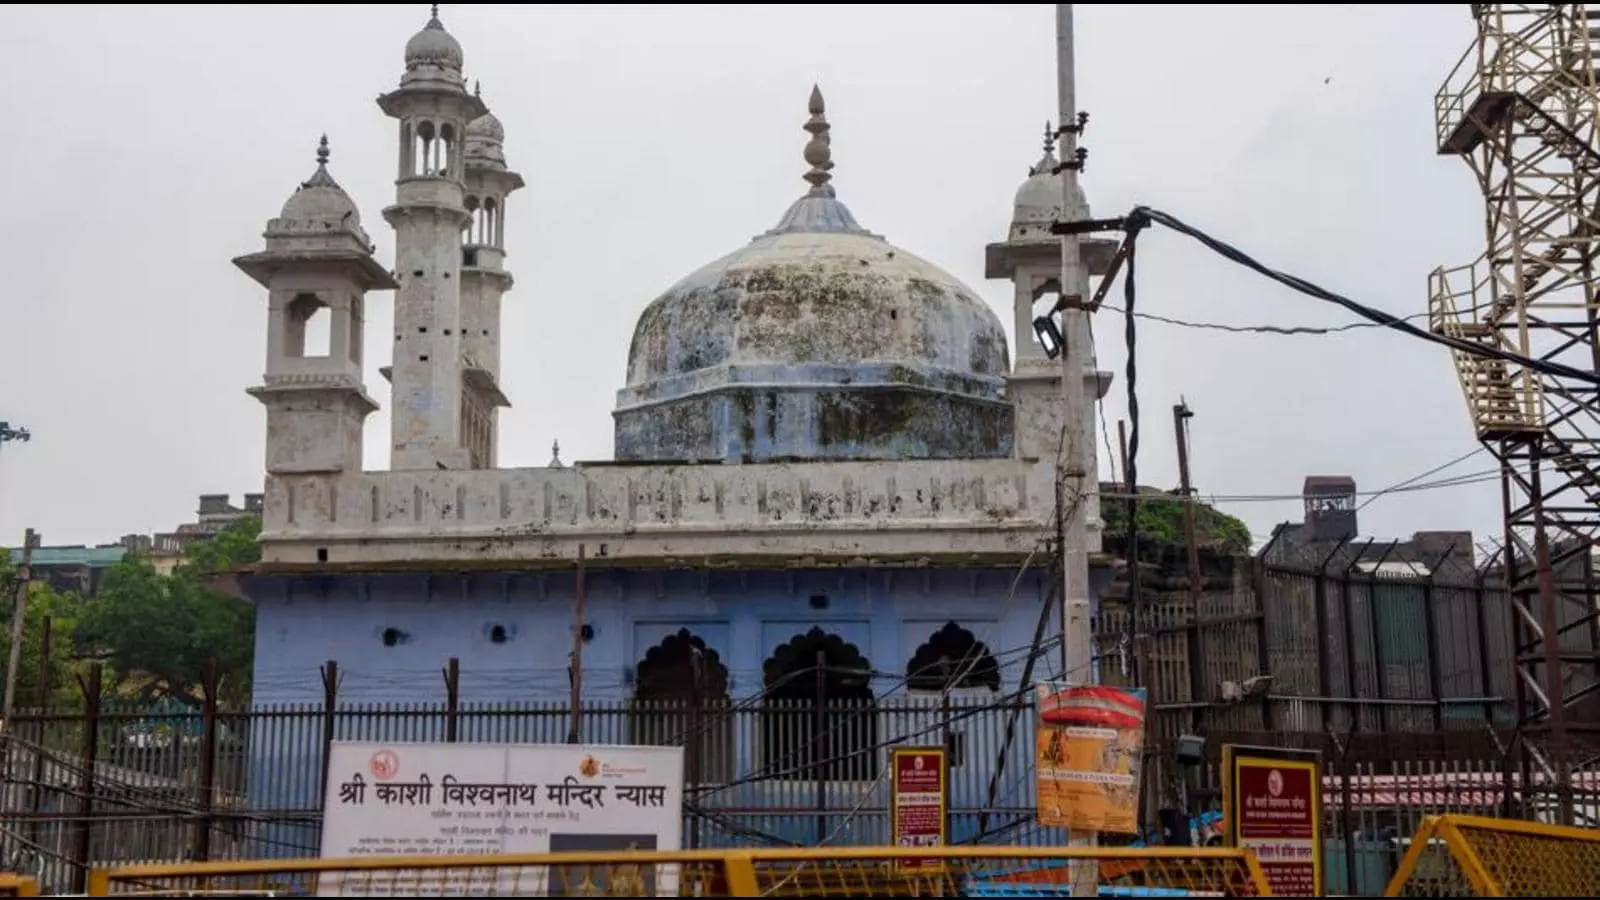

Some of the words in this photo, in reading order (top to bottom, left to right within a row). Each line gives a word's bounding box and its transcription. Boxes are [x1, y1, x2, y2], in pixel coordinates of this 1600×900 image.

[339, 773, 366, 804] श्री
[375, 773, 433, 805] काशी
[442, 774, 537, 806] विश्वनाथ
[546, 775, 607, 808] मन्दिर
[615, 785, 666, 807] न्यास
